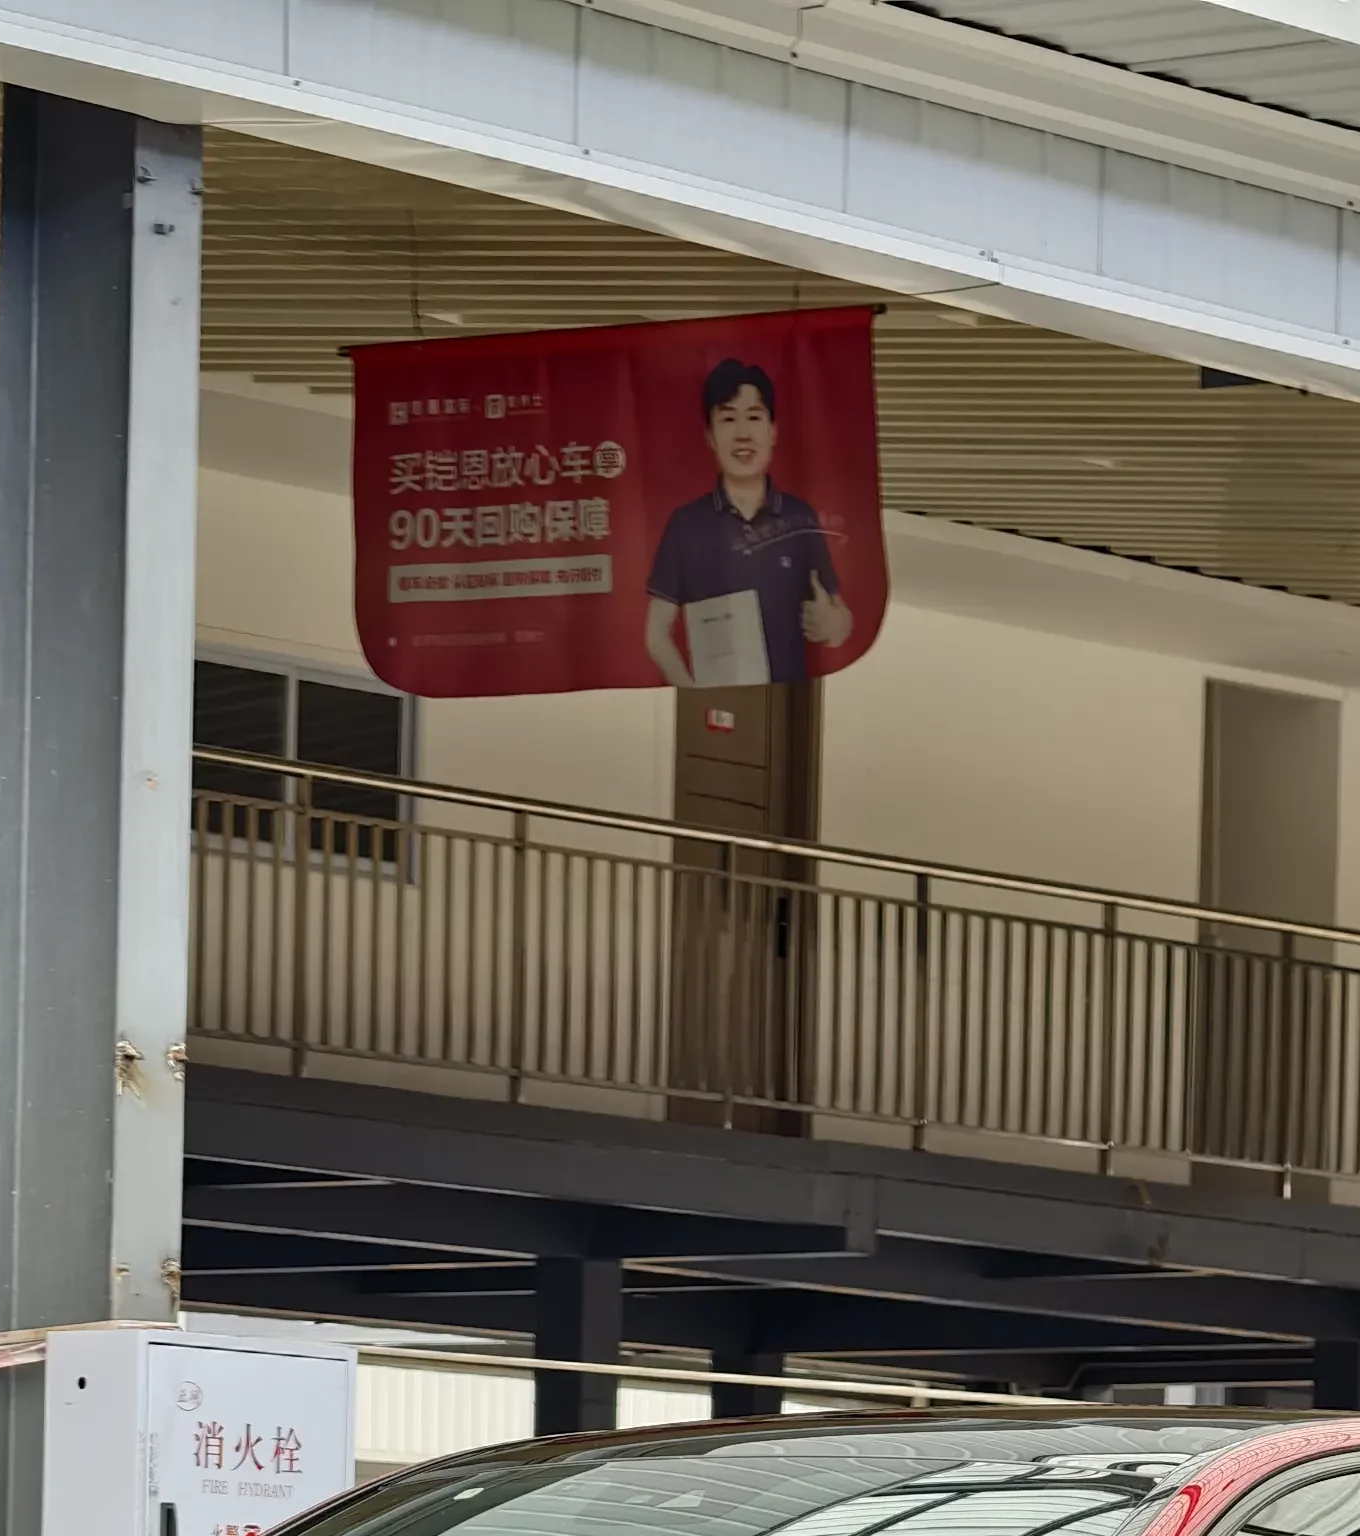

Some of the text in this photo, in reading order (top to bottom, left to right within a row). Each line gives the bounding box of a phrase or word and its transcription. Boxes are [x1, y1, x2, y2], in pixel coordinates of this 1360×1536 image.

[388, 497, 612, 551] 90天回购保障
[193, 1420, 303, 1475] 消火栓
[201, 1478, 295, 1499] FIRE HYDRANT
